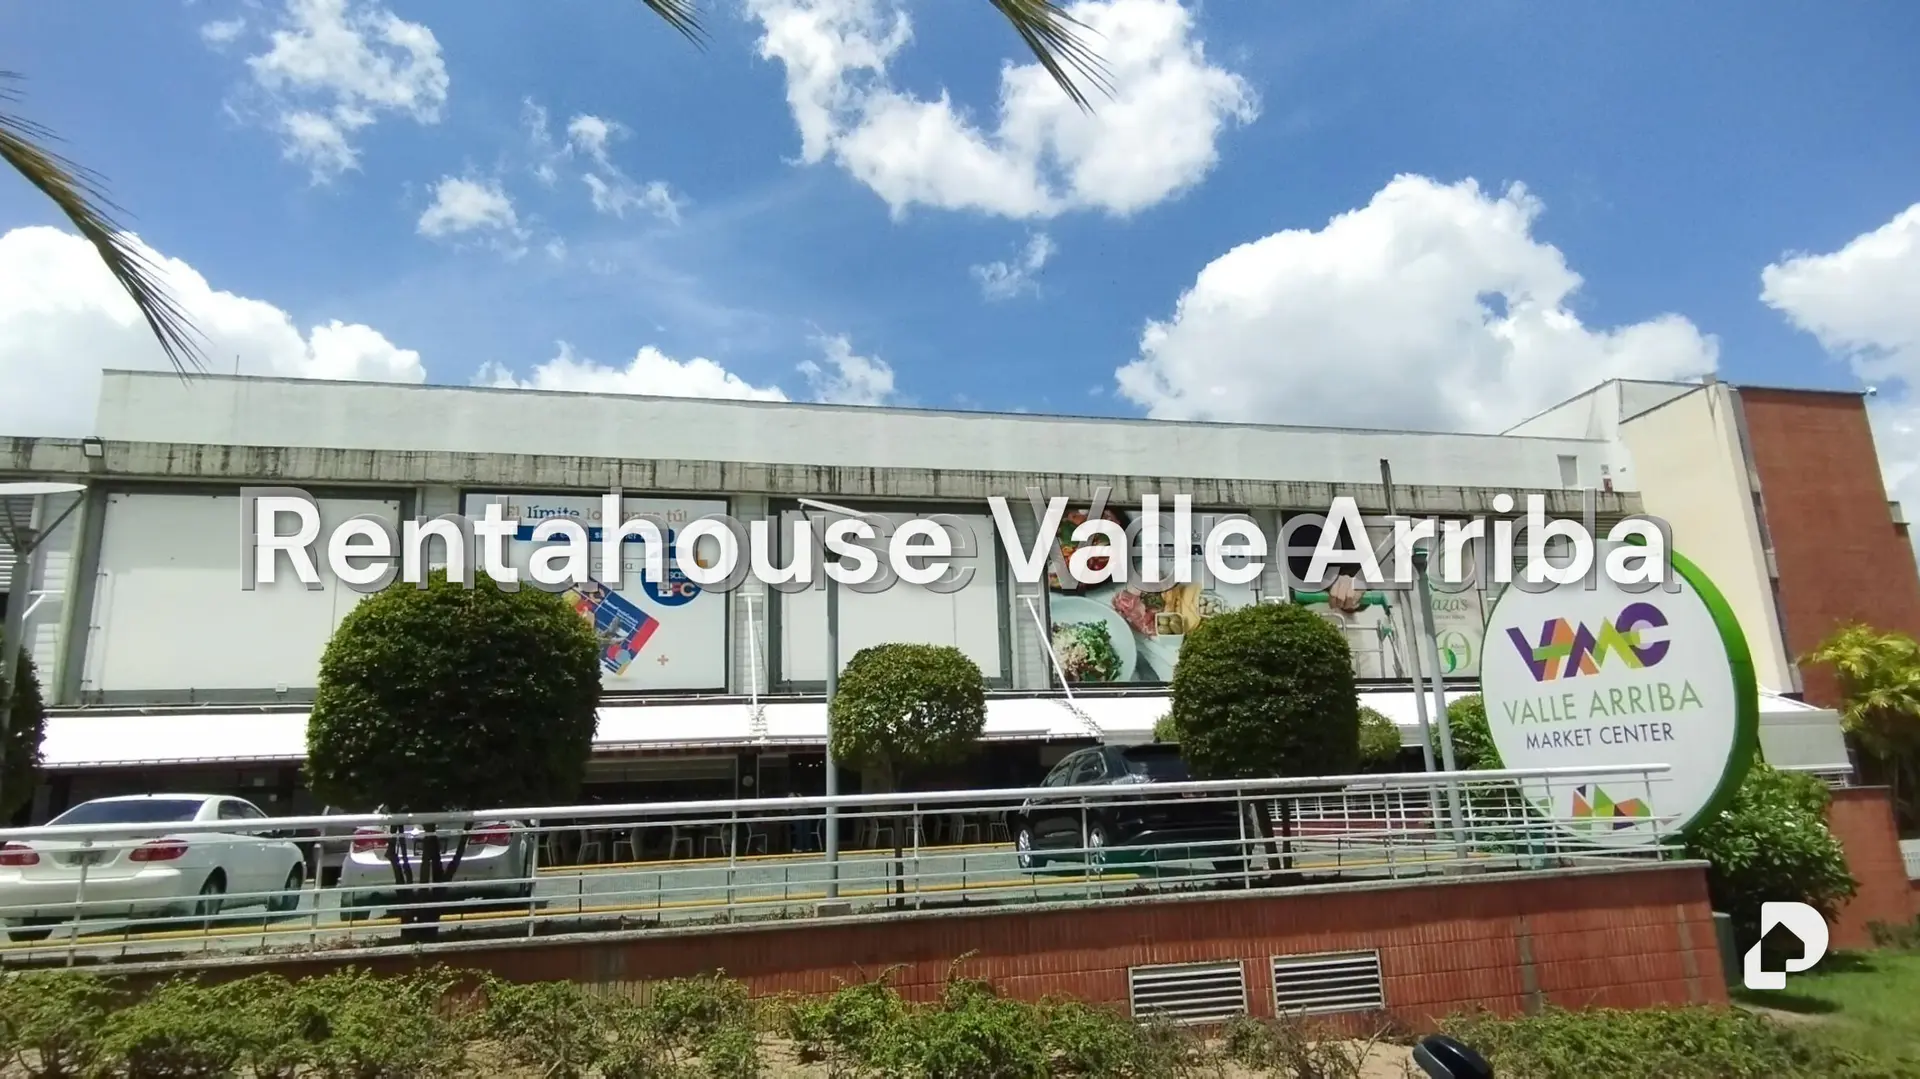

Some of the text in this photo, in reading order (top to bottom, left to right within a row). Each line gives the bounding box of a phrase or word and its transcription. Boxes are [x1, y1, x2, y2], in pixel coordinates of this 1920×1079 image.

[527, 505, 580, 519] límite
[1503, 679, 1704, 725] VALLE ARRIBA
[1526, 722, 1675, 750] MARKET CENTER
